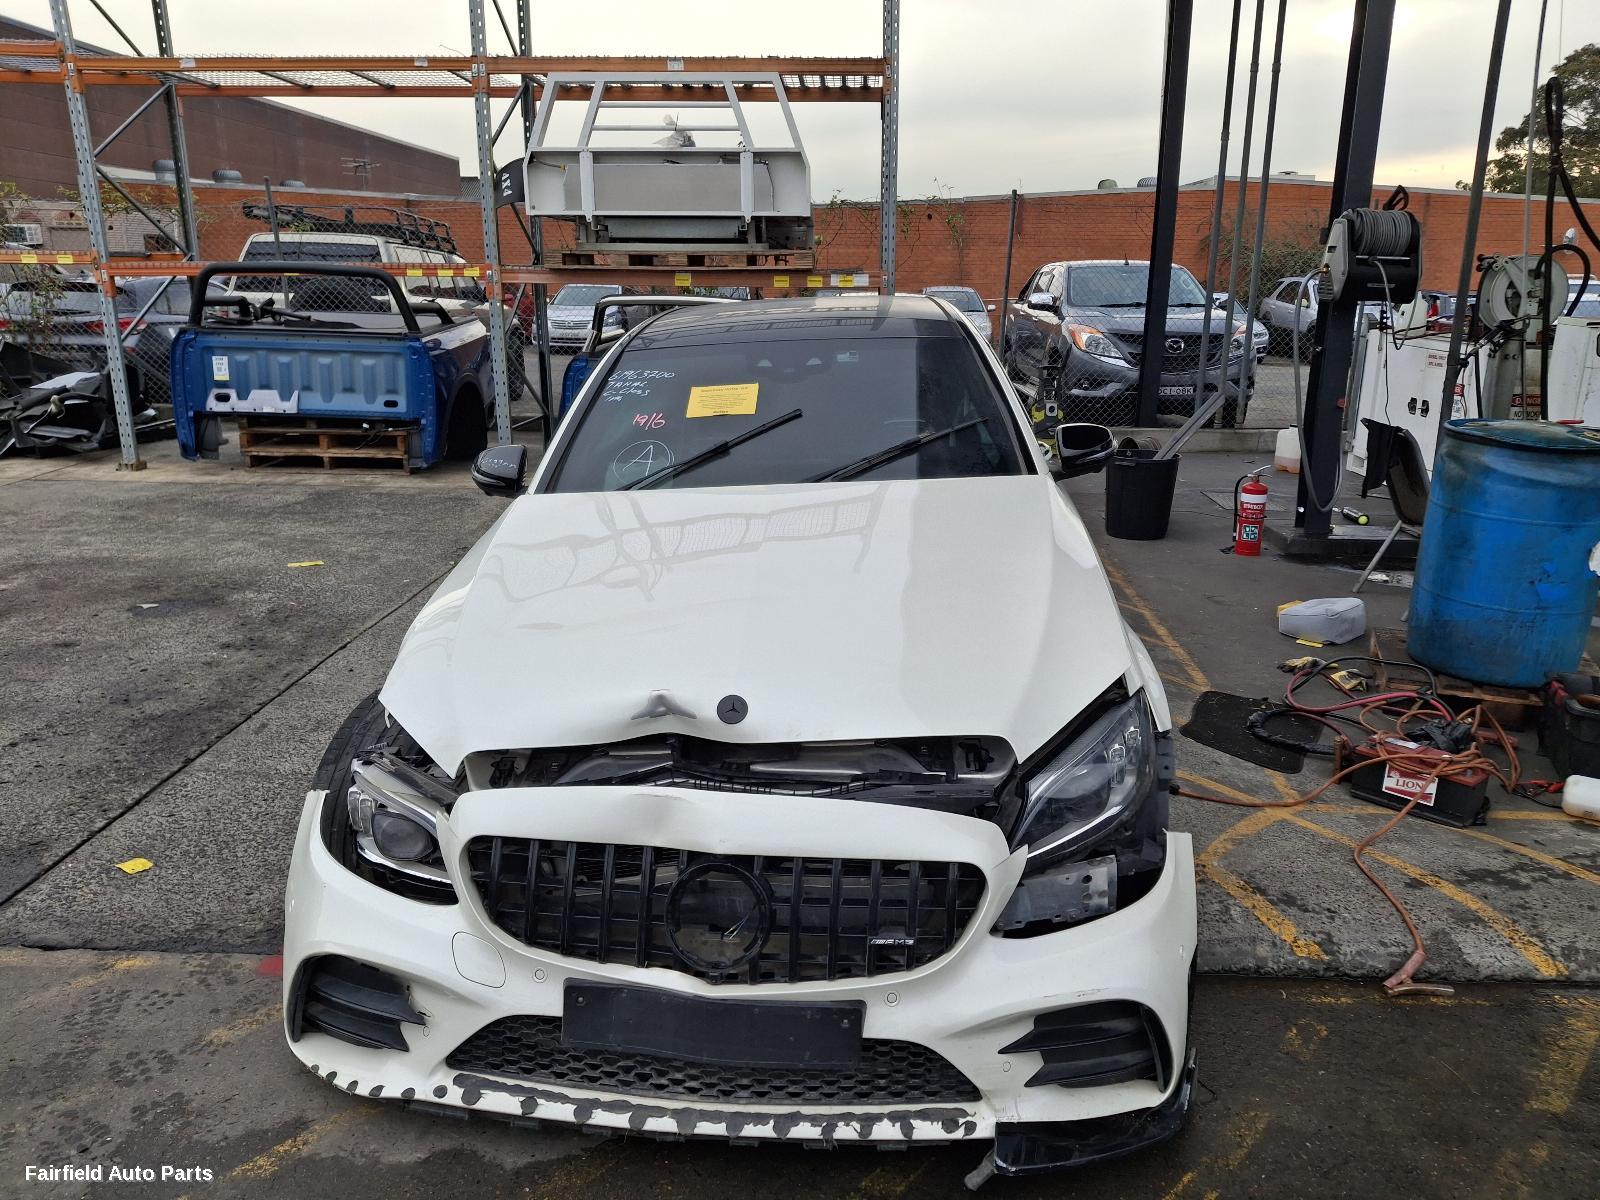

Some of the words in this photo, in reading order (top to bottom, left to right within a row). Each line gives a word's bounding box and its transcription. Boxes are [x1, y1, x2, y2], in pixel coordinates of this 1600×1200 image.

[632, 412, 667, 431] 19/6
[622, 444, 654, 477] A
[1395, 778, 1424, 791] LION
